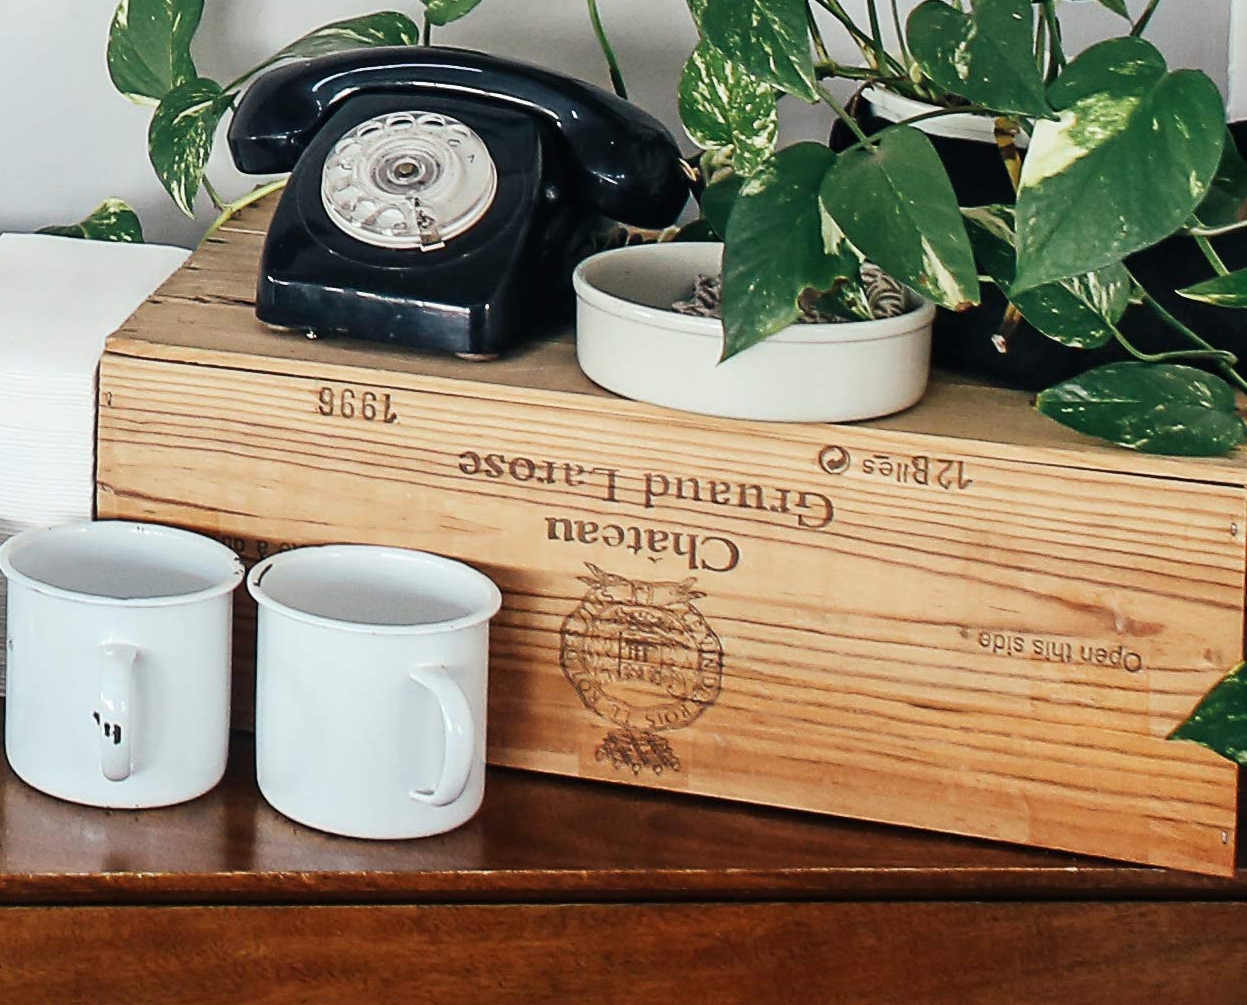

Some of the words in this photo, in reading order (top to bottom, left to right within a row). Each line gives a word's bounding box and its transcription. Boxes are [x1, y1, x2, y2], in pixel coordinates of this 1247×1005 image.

[318, 386, 399, 425] 1996
[458, 450, 620, 503] Larose
[644, 472, 835, 528] Gruaud
[544, 516, 740, 572] Château
[978, 631, 1025, 656] side
[1032, 639, 1072, 663] this
[1081, 645, 1142, 672] Open
